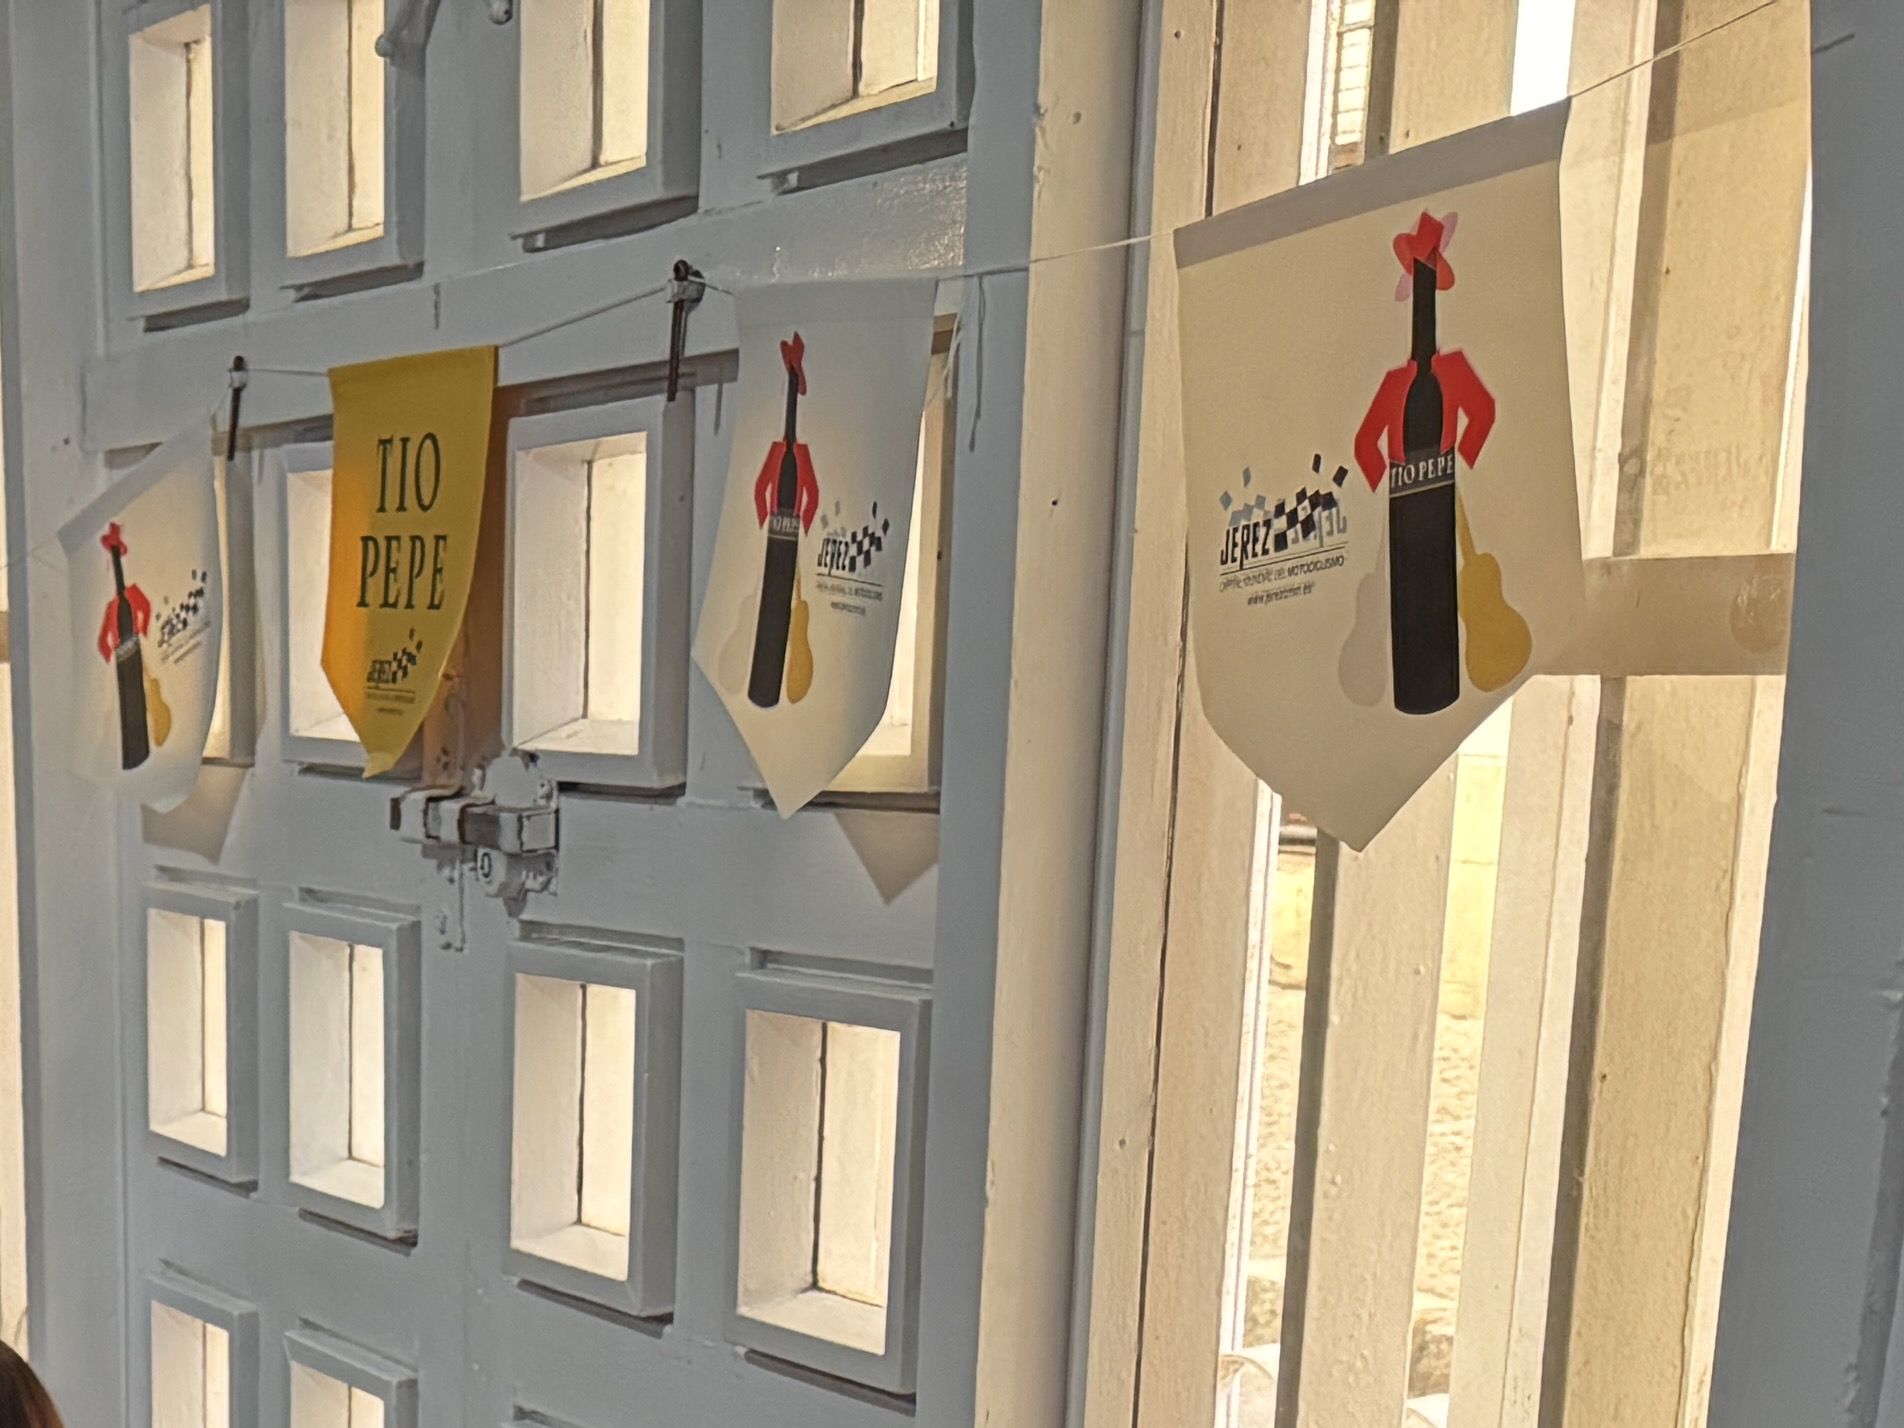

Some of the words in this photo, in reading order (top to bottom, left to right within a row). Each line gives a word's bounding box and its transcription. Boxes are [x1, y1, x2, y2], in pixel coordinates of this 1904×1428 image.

[376, 432, 441, 514] TIO
[1390, 464, 1415, 489] TIO
[1418, 453, 1454, 481] PEPE
[356, 534, 448, 611] PEPE
[1220, 518, 1272, 571] JEREZ
